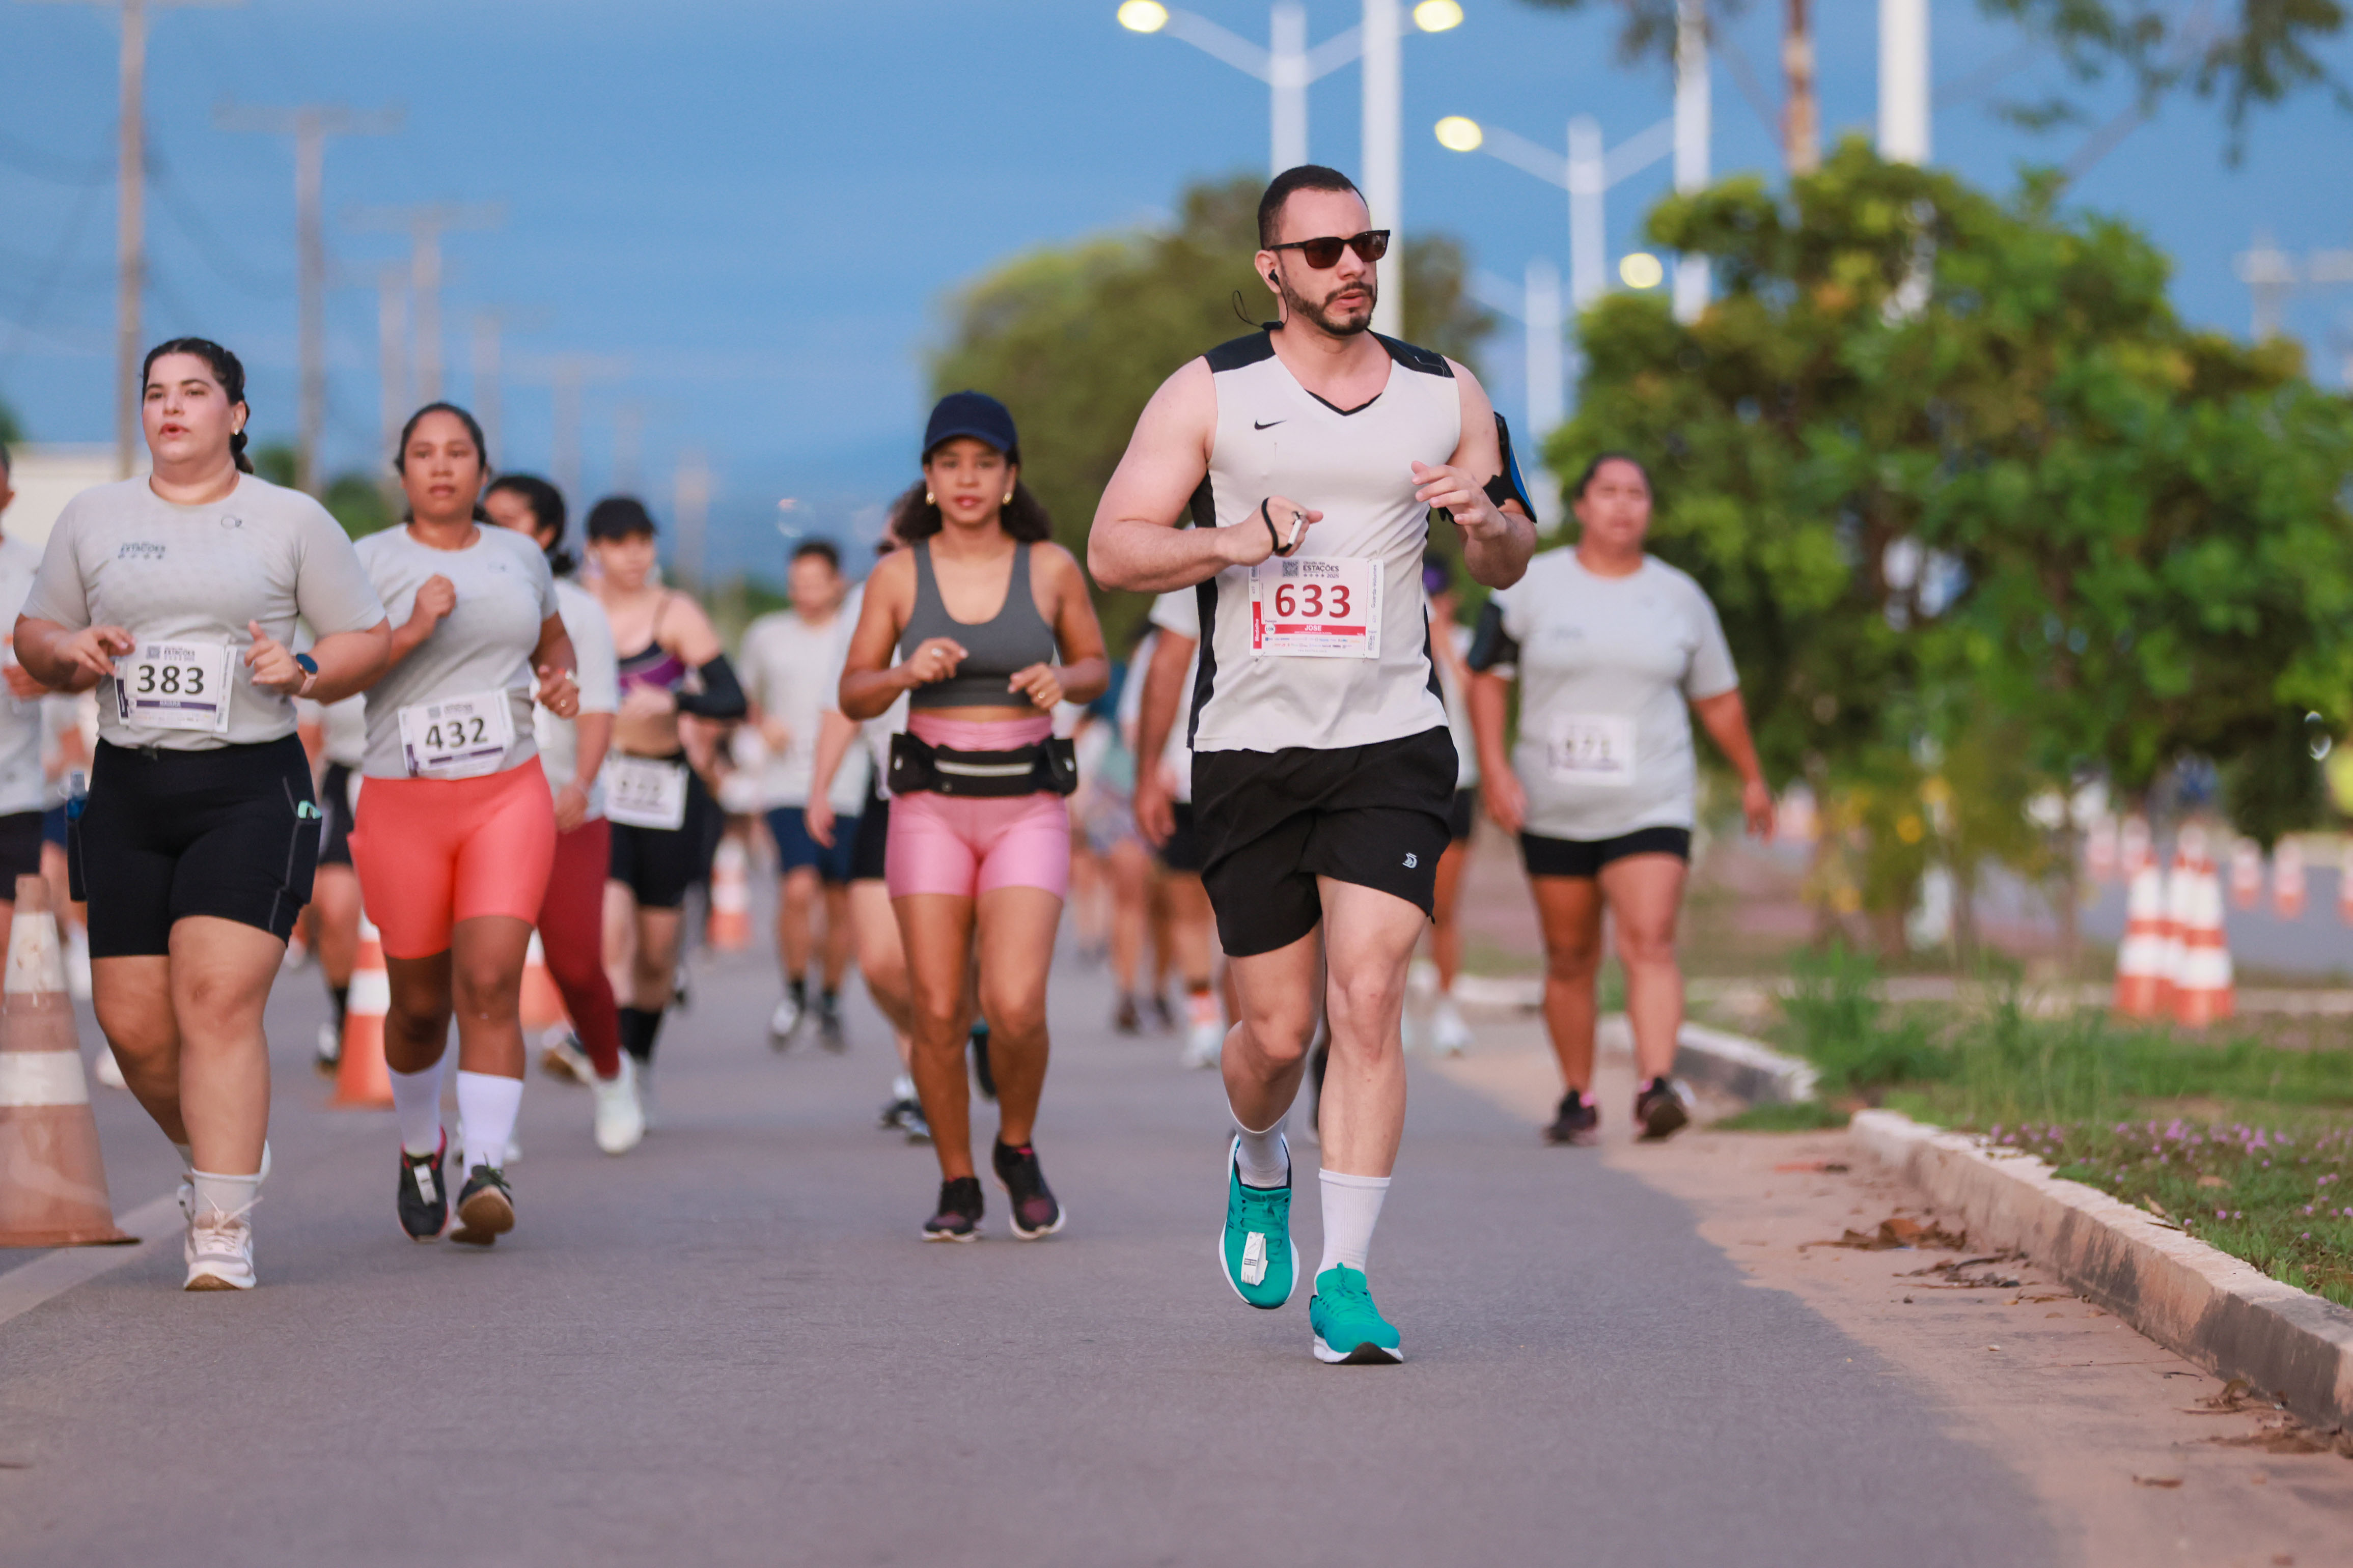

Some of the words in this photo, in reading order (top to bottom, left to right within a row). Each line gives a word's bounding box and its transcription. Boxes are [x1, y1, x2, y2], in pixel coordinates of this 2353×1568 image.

[1303, 565, 1339, 573] ESTAÇÕES
[1275, 583, 1351, 618] 633
[137, 665, 204, 695] 383
[426, 717, 488, 749] 432
